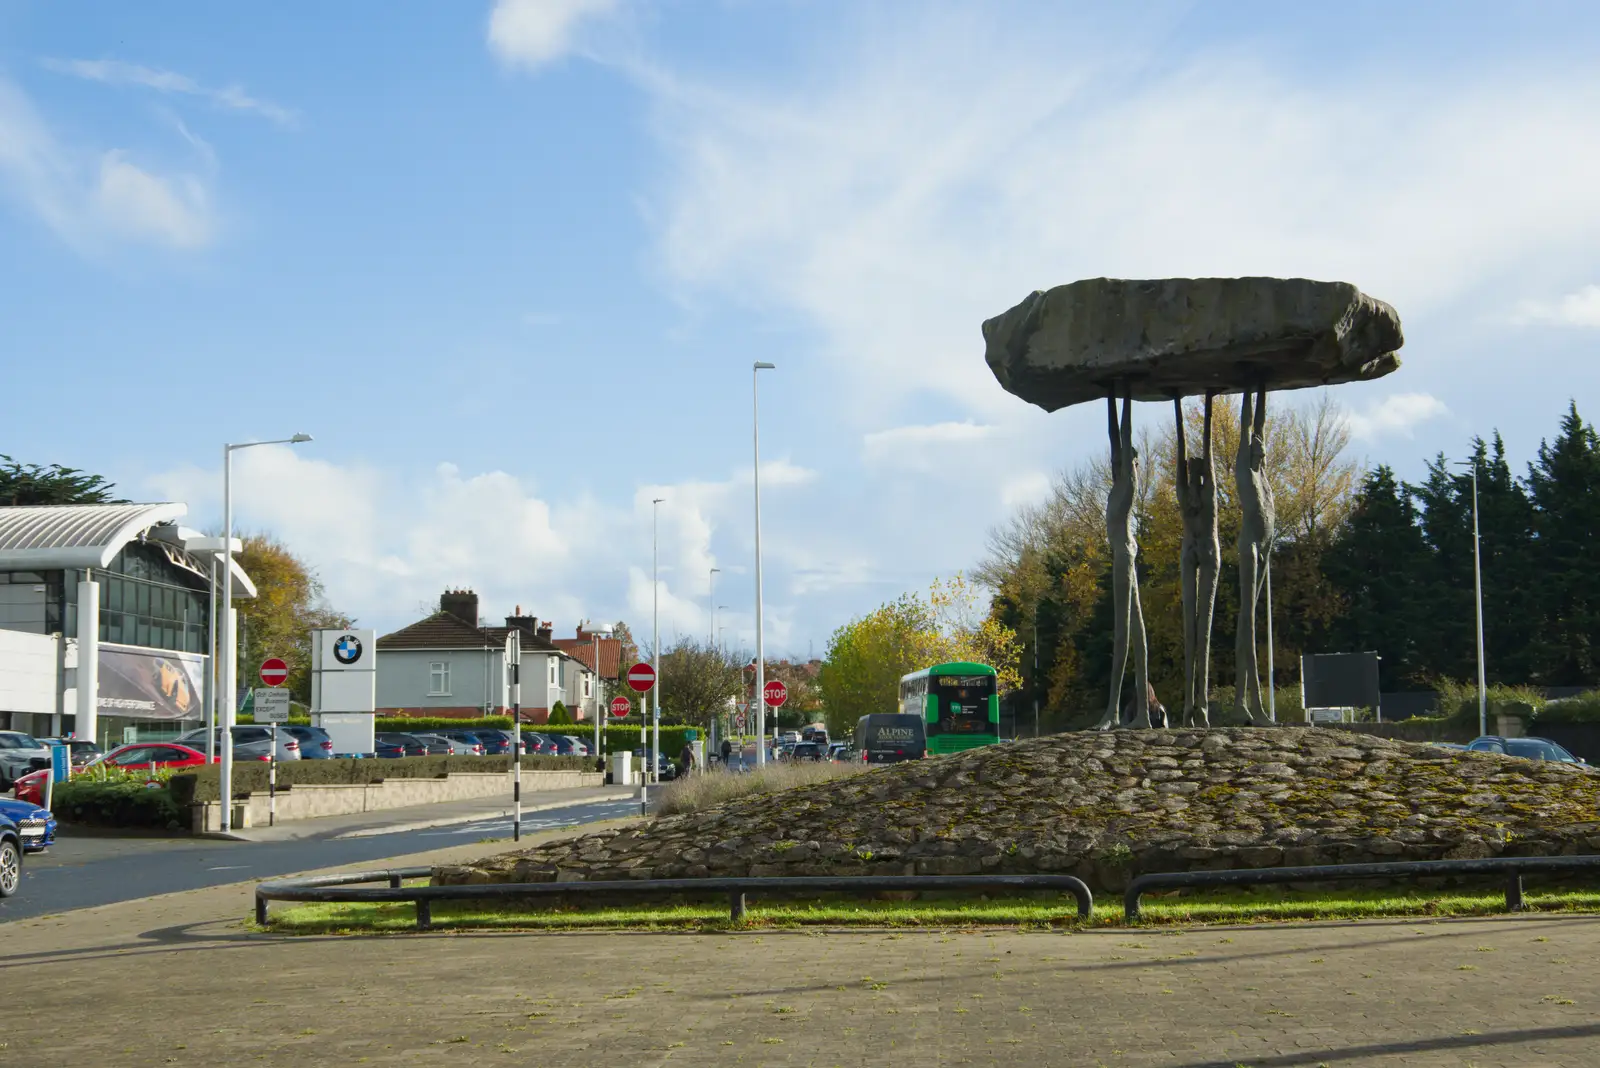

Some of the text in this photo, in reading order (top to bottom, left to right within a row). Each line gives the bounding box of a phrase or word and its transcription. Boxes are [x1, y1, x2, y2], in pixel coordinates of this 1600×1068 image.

[335, 635, 360, 646] BMW
[764, 688, 786, 699] STOP
[612, 703, 630, 711] STOP
[877, 727, 914, 736] ALPINE
